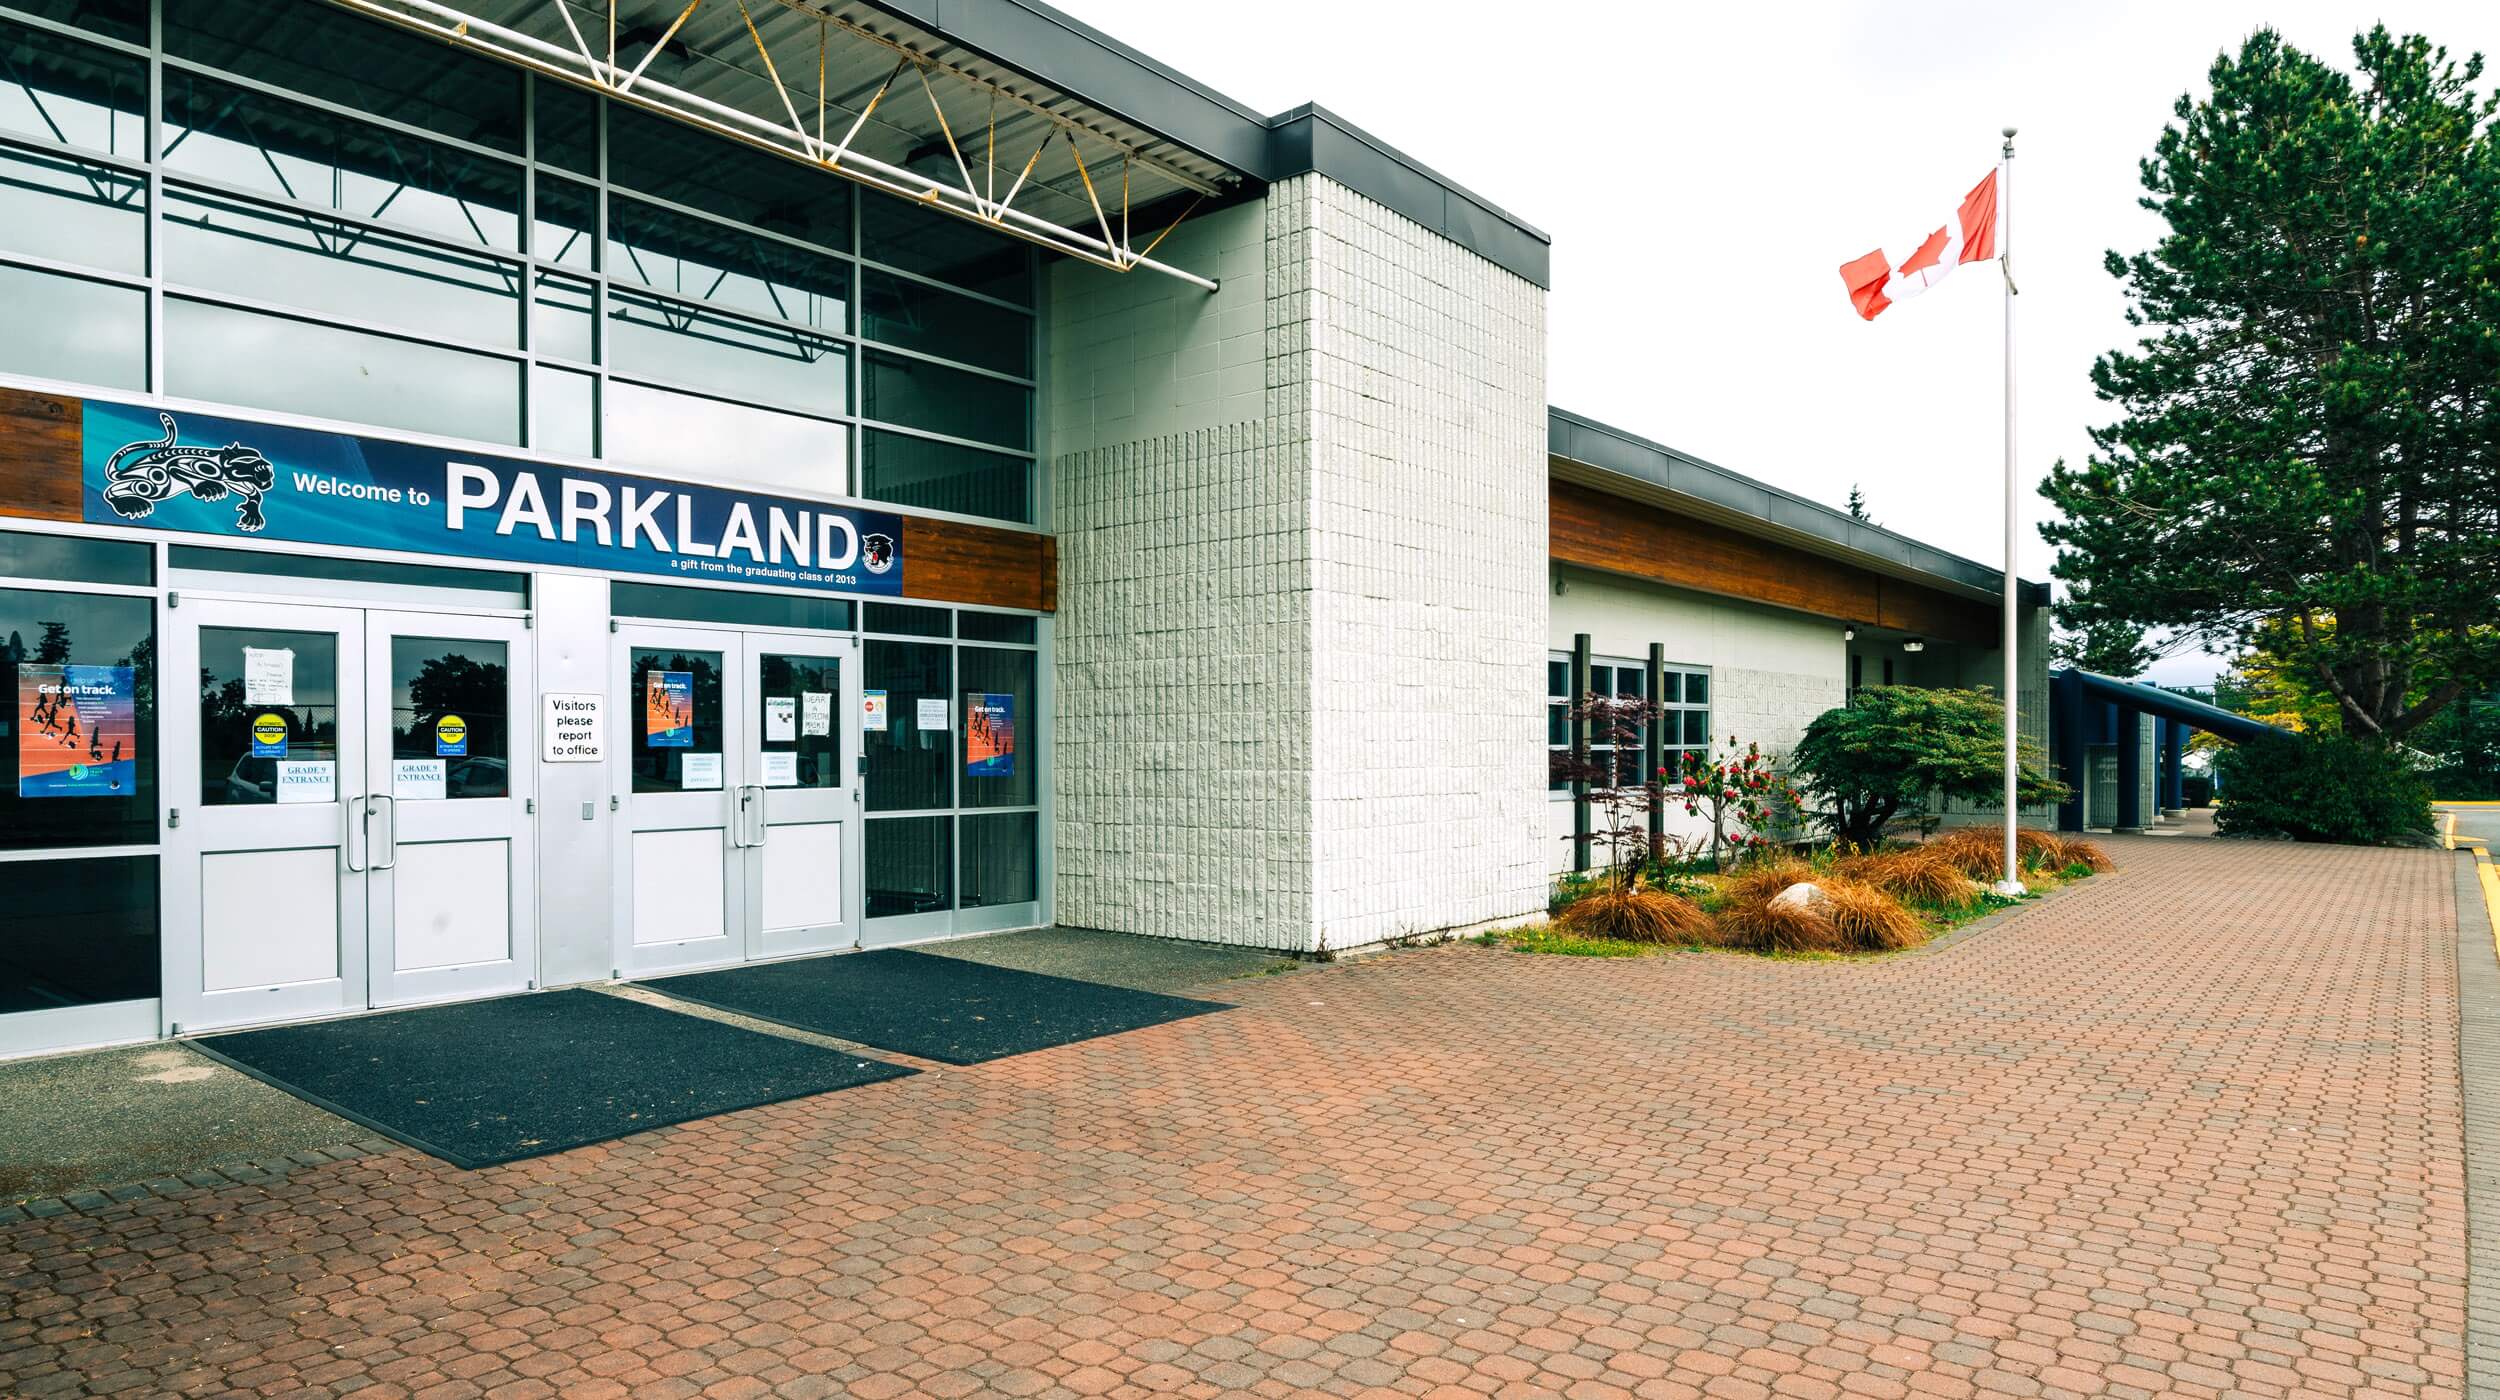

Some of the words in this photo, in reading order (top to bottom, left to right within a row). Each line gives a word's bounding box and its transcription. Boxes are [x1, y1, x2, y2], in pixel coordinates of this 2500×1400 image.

[293, 472, 402, 504] Welcome
[408, 489, 430, 506] to
[445, 461, 859, 570] PARKLAND
[671, 559, 678, 568] a
[681, 559, 698, 571] gift
[700, 561, 724, 572] from
[727, 562, 743, 574] the
[745, 563, 797, 581] graduating
[799, 570, 822, 582] class
[825, 574, 834, 583] of
[835, 574, 857, 585] 2013
[38, 684, 62, 694] Get
[63, 686, 79, 694] on
[81, 685, 116, 695] track.
[552, 700, 596, 711] Visitors
[557, 716, 593, 728] please
[558, 731, 592, 742] report
[552, 746, 564, 755] to
[567, 745, 598, 755] office
[287, 766, 321, 775] GRADE
[321, 766, 326, 774] 9
[402, 764, 432, 773] GRADE
[282, 775, 331, 784] ENTRANCE
[397, 773, 442, 782] ENTRANCE
